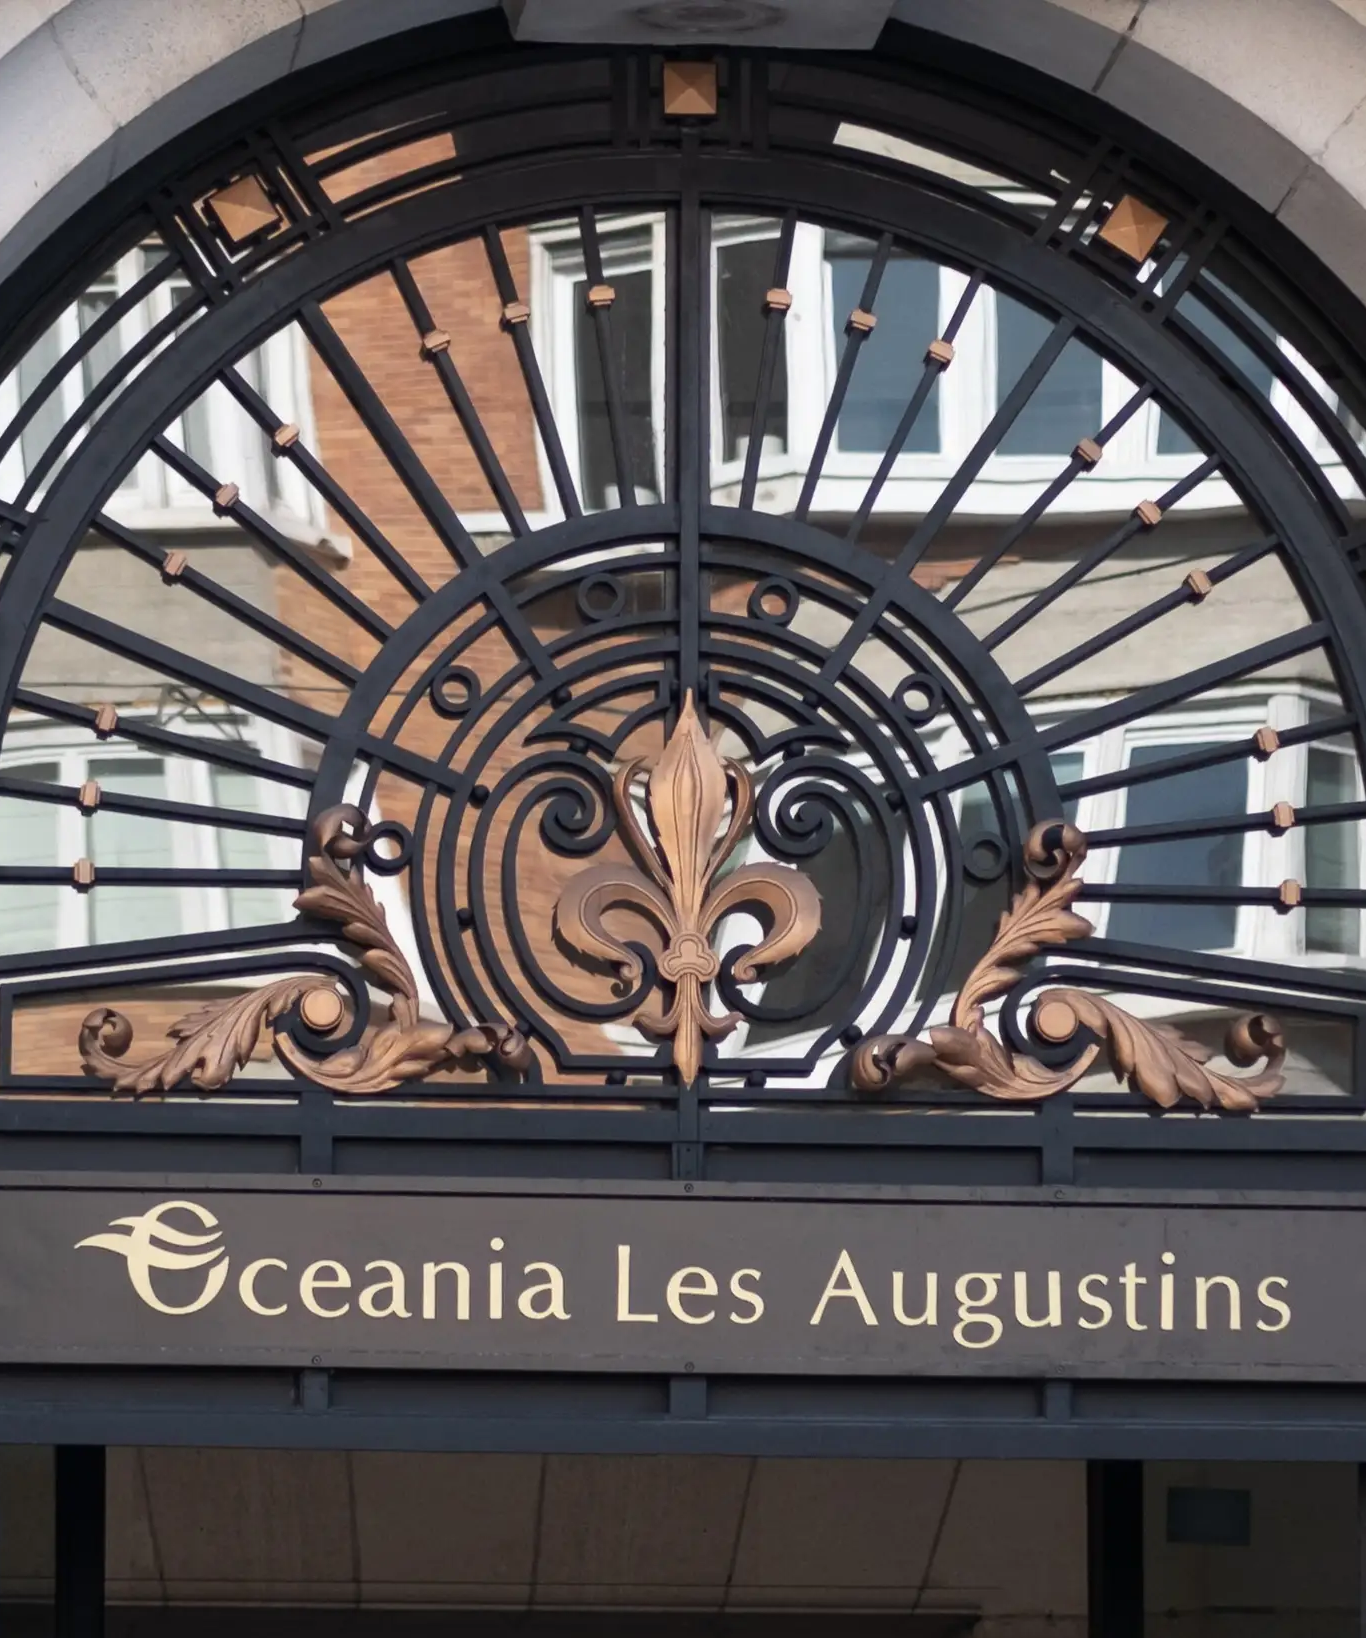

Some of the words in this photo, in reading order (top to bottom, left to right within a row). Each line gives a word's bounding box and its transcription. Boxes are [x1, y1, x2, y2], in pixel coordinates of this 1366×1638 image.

[73, 1200, 572, 1321] Oceania
[615, 1243, 765, 1325] Les
[808, 1248, 1292, 1350] Augustins
